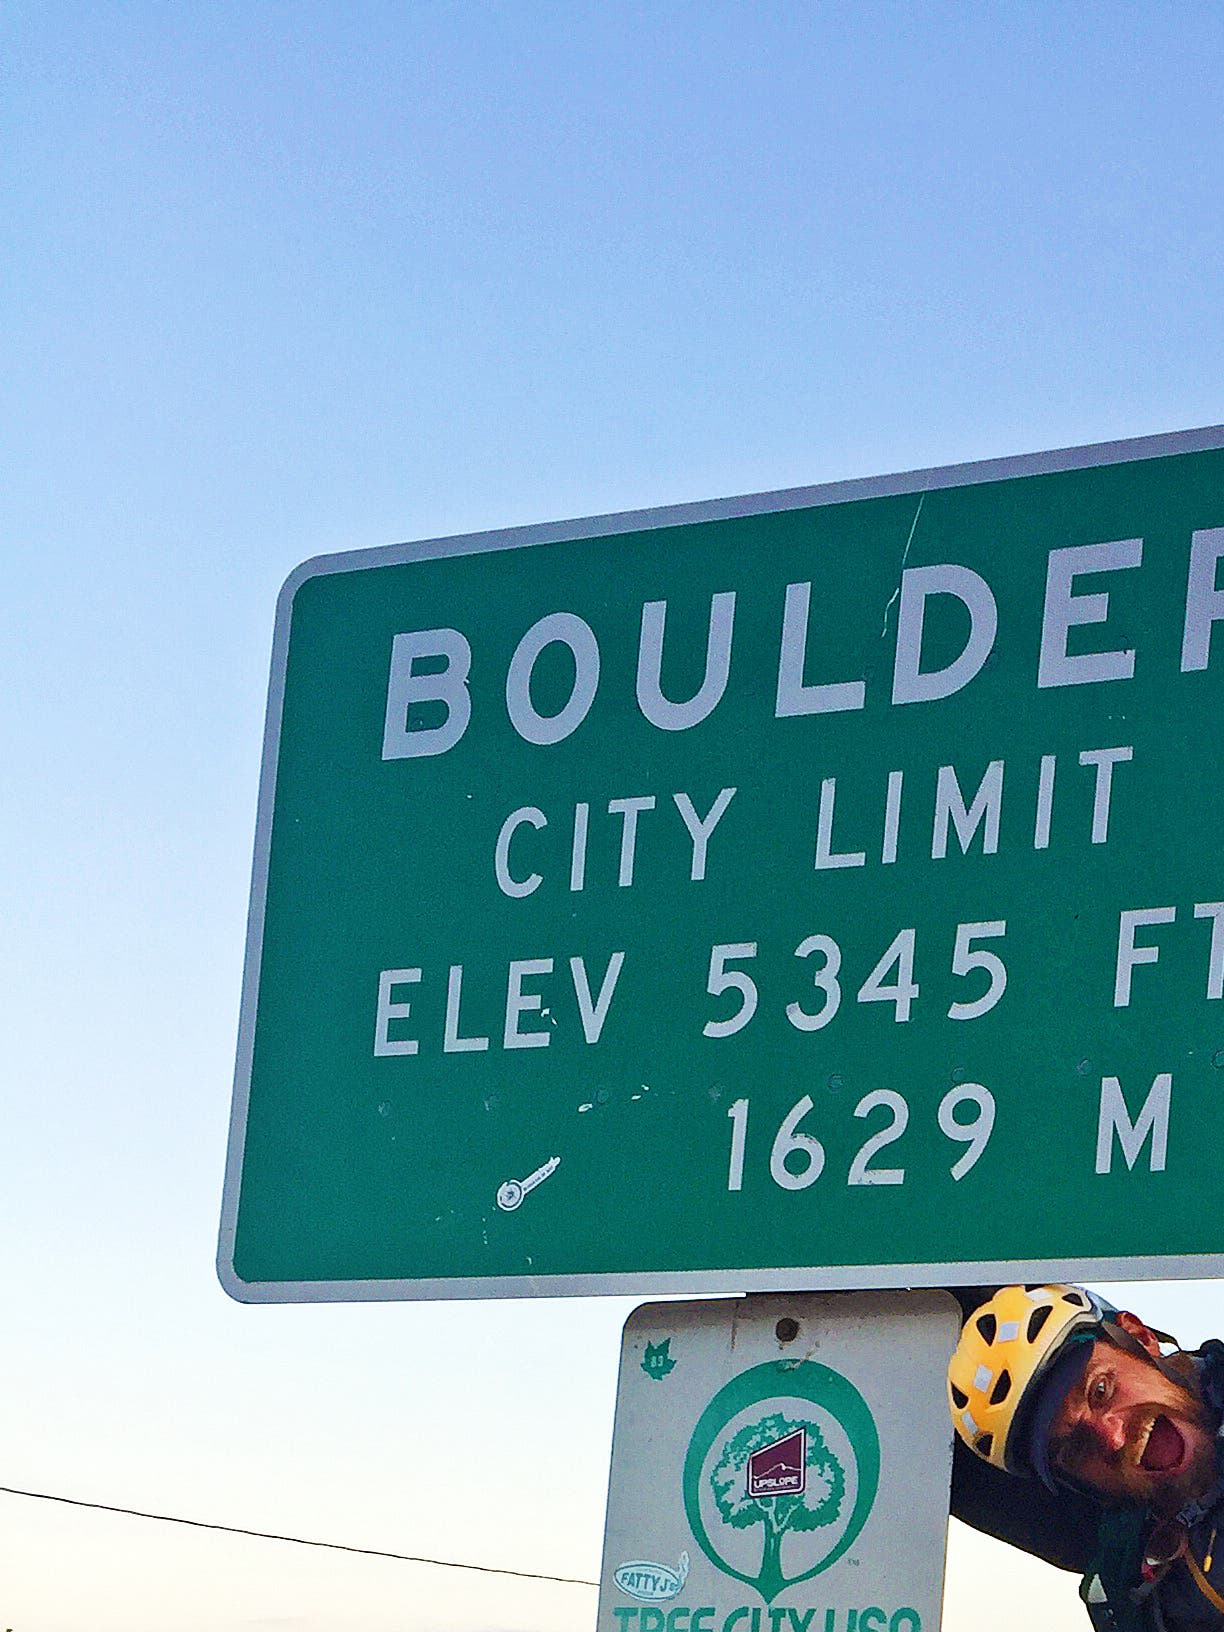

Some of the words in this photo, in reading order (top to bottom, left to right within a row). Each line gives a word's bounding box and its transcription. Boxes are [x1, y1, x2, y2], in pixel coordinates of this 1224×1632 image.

[494, 787, 737, 899] CITY
[814, 746, 1134, 870] LIMIT
[373, 951, 625, 1057] ELEV
[703, 920, 1008, 1038] 5345
[726, 1083, 996, 1191] 1629
[1095, 1073, 1172, 1174] M
[754, 1476, 799, 1488] UPSLOPE
